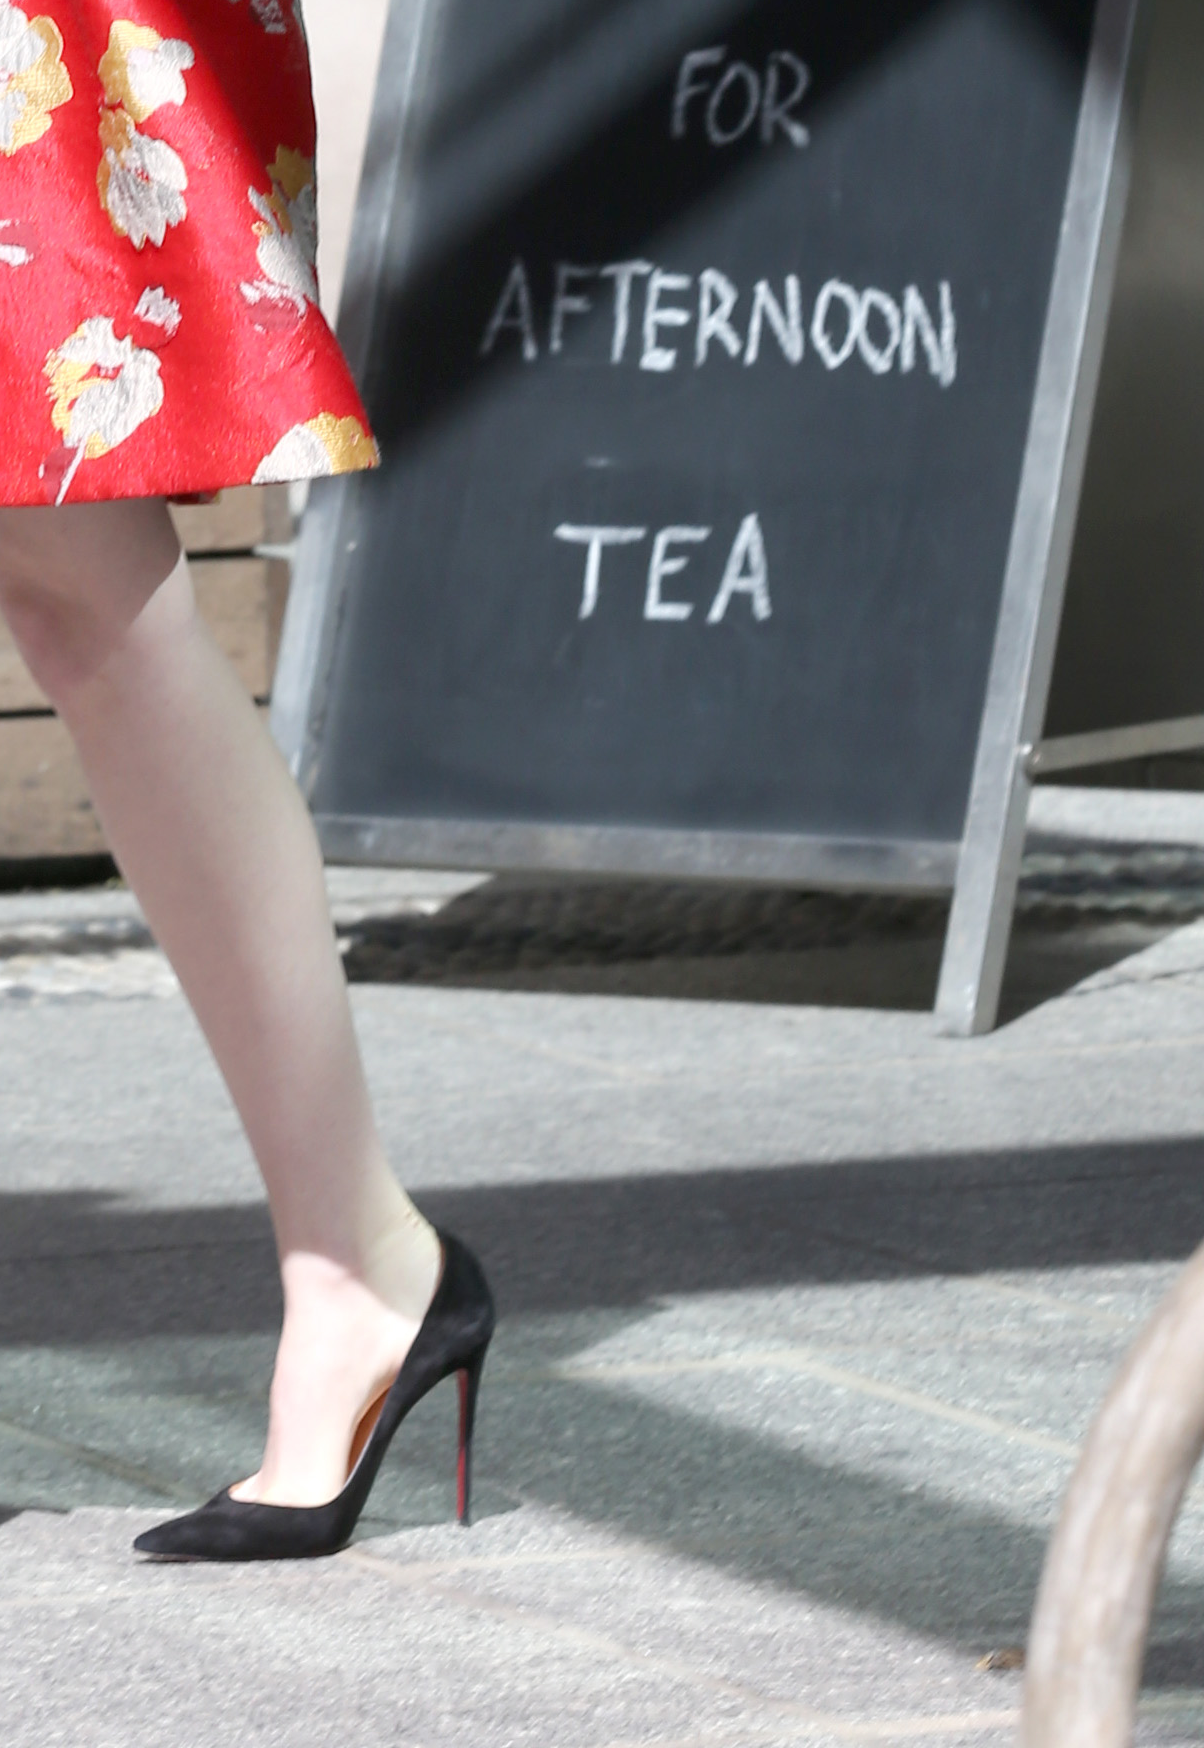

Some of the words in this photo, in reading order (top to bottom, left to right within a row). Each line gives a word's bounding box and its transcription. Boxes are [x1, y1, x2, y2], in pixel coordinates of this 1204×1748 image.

[672, 48, 810, 147] FOR
[482, 260, 957, 388] AFTERNOON
[554, 513, 772, 624] TEA
